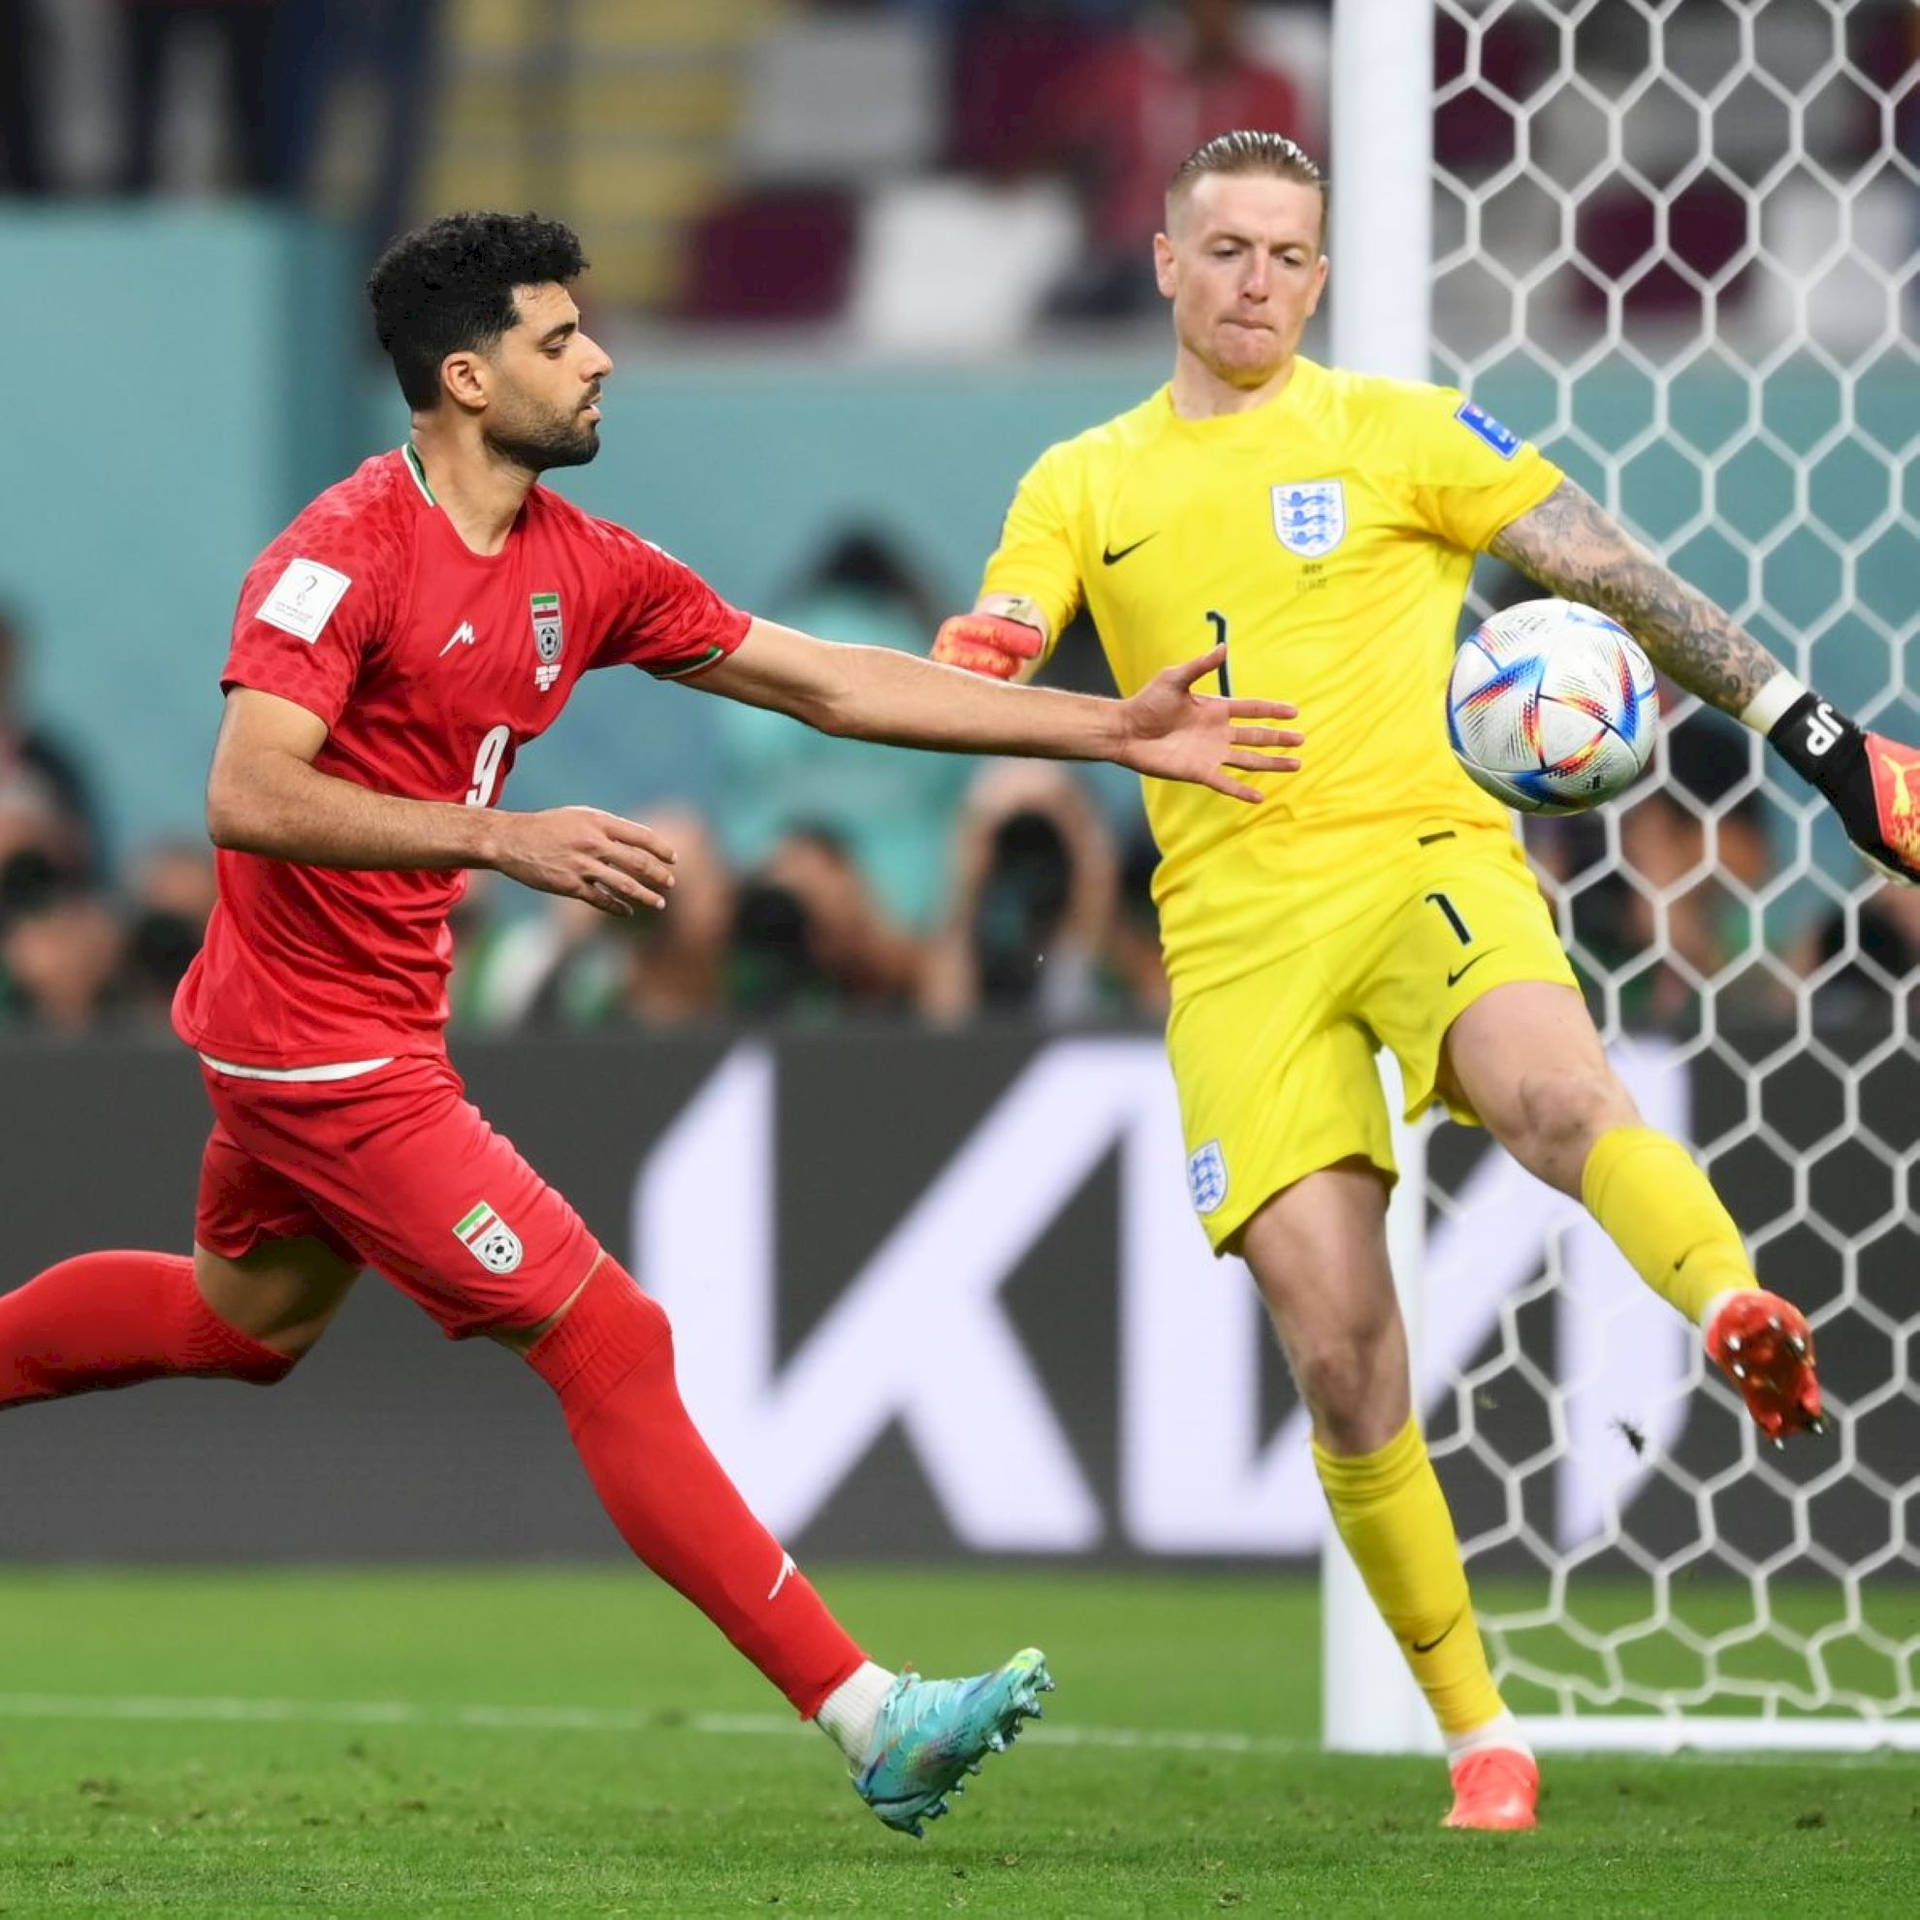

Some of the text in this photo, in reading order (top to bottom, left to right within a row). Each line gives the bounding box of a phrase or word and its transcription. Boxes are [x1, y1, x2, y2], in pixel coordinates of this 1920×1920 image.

[1206, 611, 1230, 697] 1
[1806, 702, 1844, 756] JP
[466, 725, 510, 807] 9
[1425, 893, 1471, 946] 1
